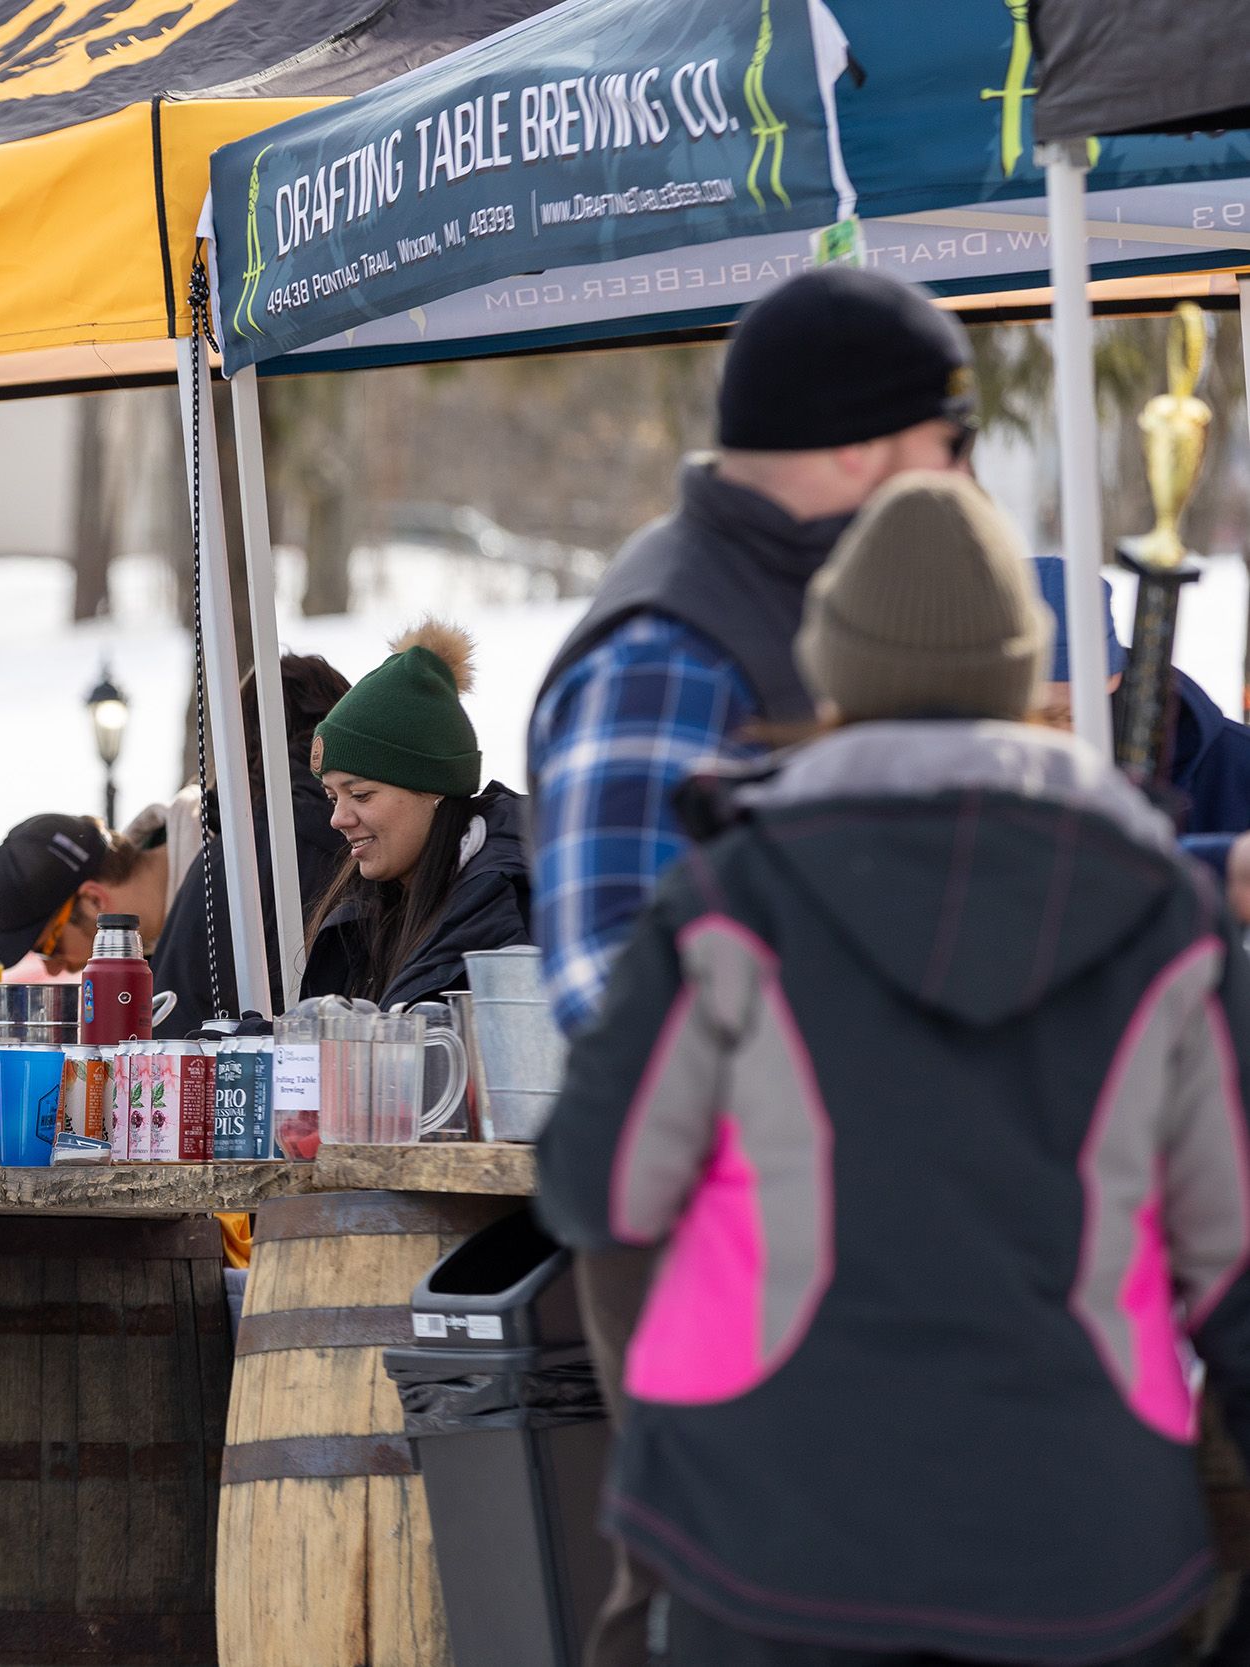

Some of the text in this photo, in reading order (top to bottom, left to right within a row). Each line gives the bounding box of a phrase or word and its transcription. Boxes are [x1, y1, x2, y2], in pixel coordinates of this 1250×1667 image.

[276, 58, 740, 257] DRAFTING TABLE BREWING CO.
[266, 204, 516, 315] 49438 PONTIAC TRAIL, WIXOM, MI, 48393
[214, 1117, 245, 1136] PILS
[215, 1088, 247, 1108] PRO
